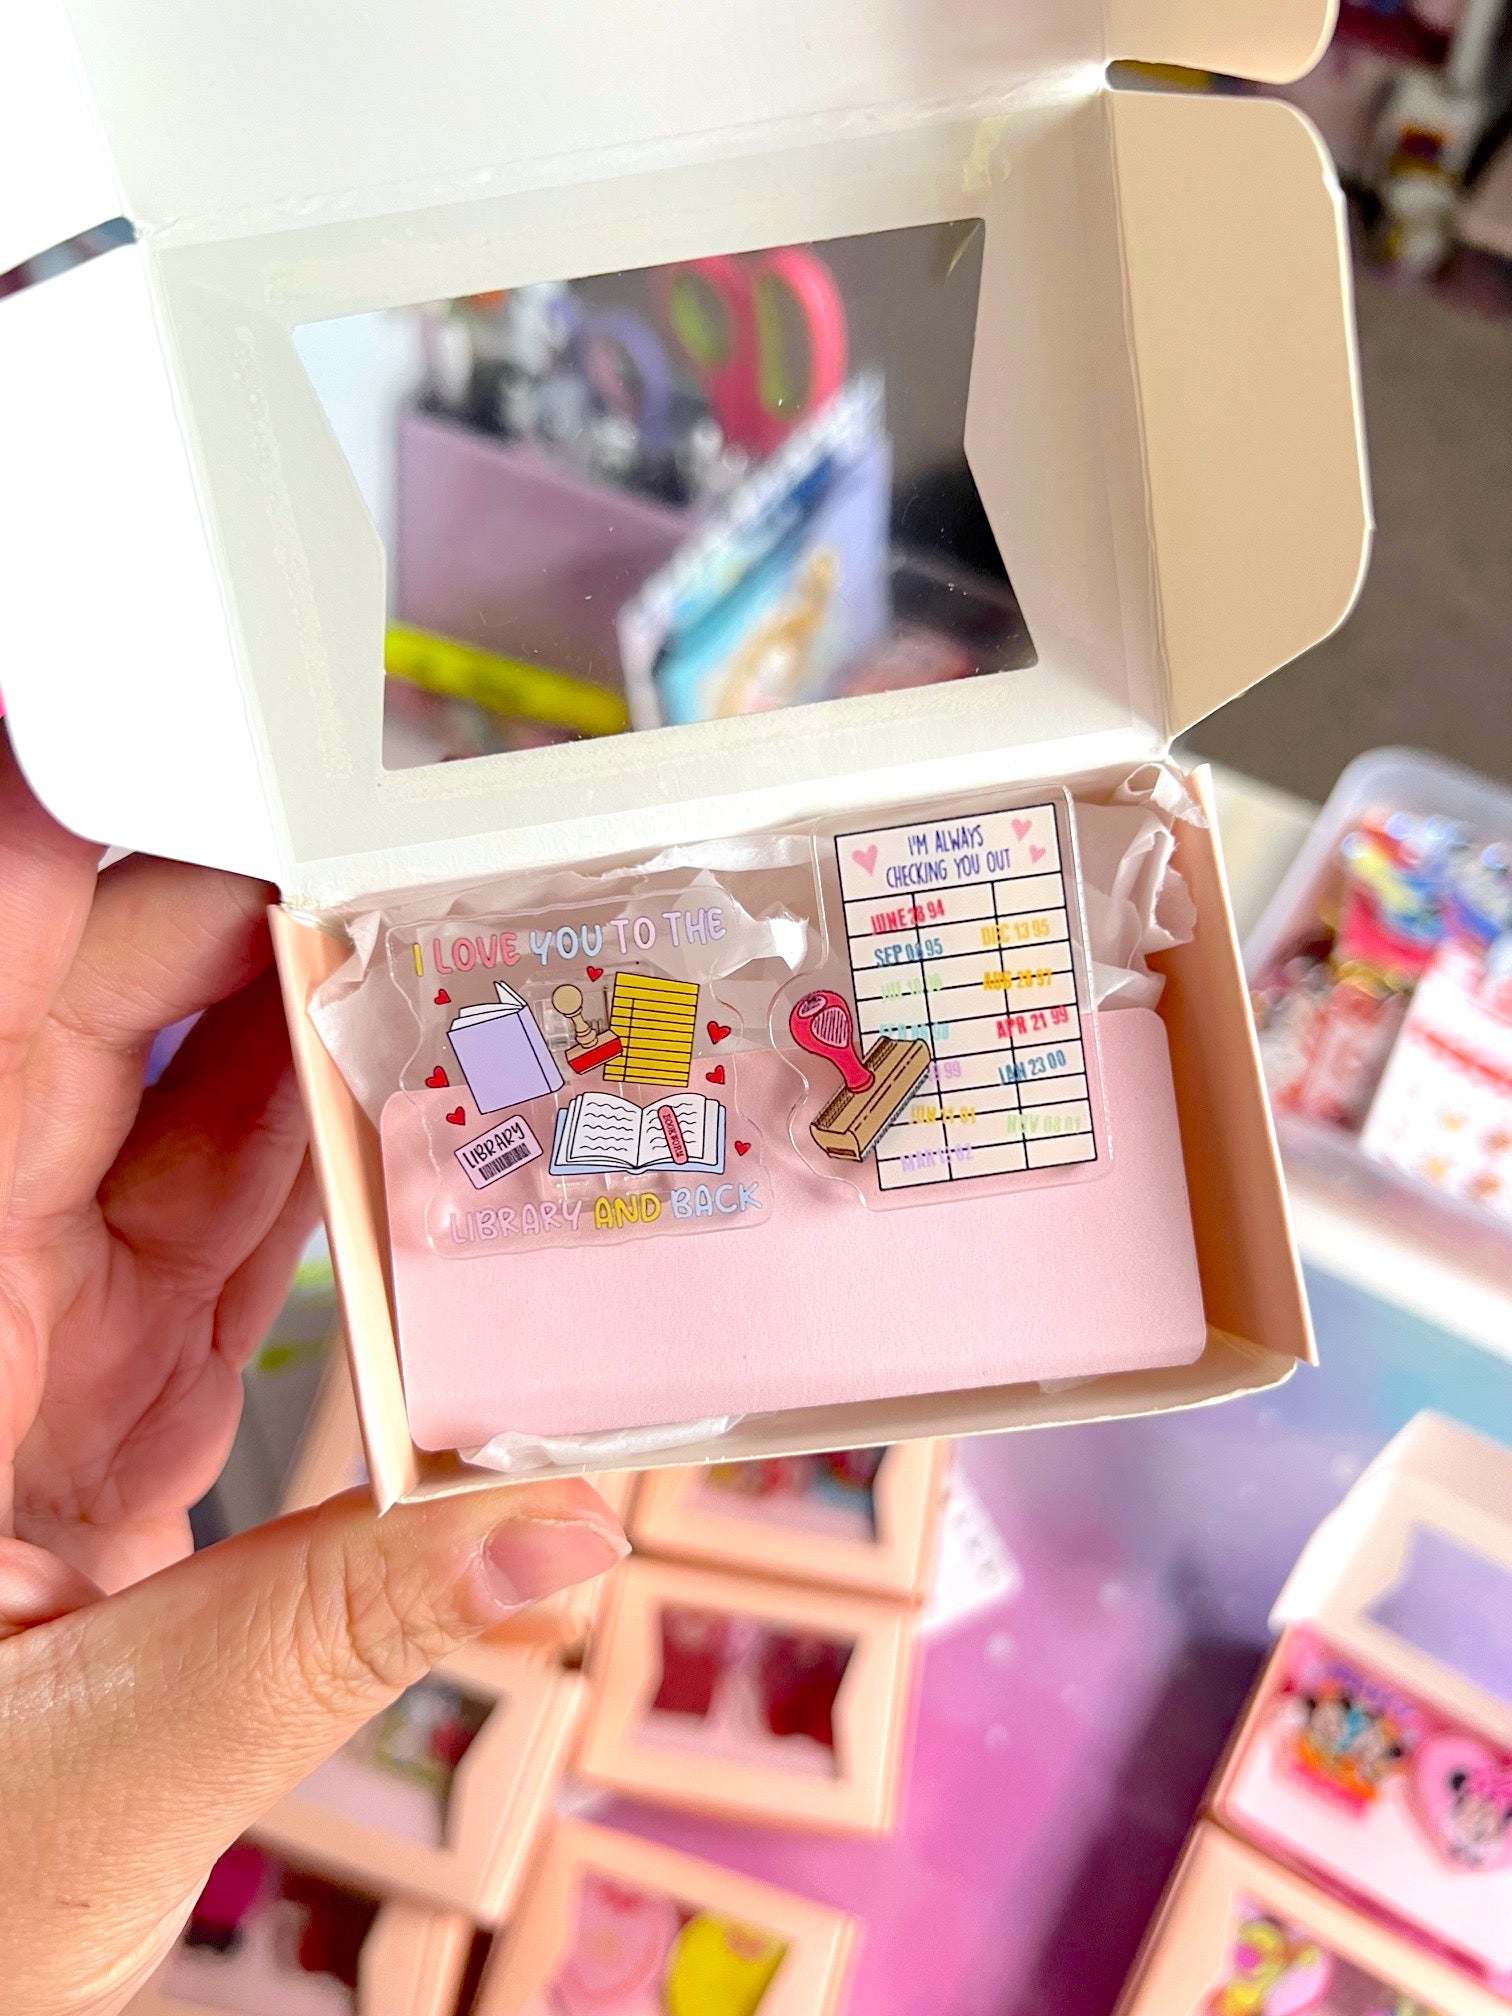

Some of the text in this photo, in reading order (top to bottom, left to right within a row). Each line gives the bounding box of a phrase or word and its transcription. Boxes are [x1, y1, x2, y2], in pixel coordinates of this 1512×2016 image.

[908, 825, 984, 856] I'M ALWAYS
[886, 848, 1011, 889] CHECKING YOU OUT
[871, 898, 945, 935] JUNE 28 94
[981, 923, 1010, 946] DEC
[413, 908, 727, 977] I LOVE YOU TO THE
[874, 944, 902, 968] SEP
[924, 938, 943, 957] 95
[996, 1005, 1070, 1040] APR 21 99
[998, 1049, 1067, 1085] JAN 23 00
[461, 1120, 526, 1170] LIBRARY
[662, 1113, 685, 1158] BOOKWORM
[447, 1181, 764, 1244] LIBRARY AND BACK
